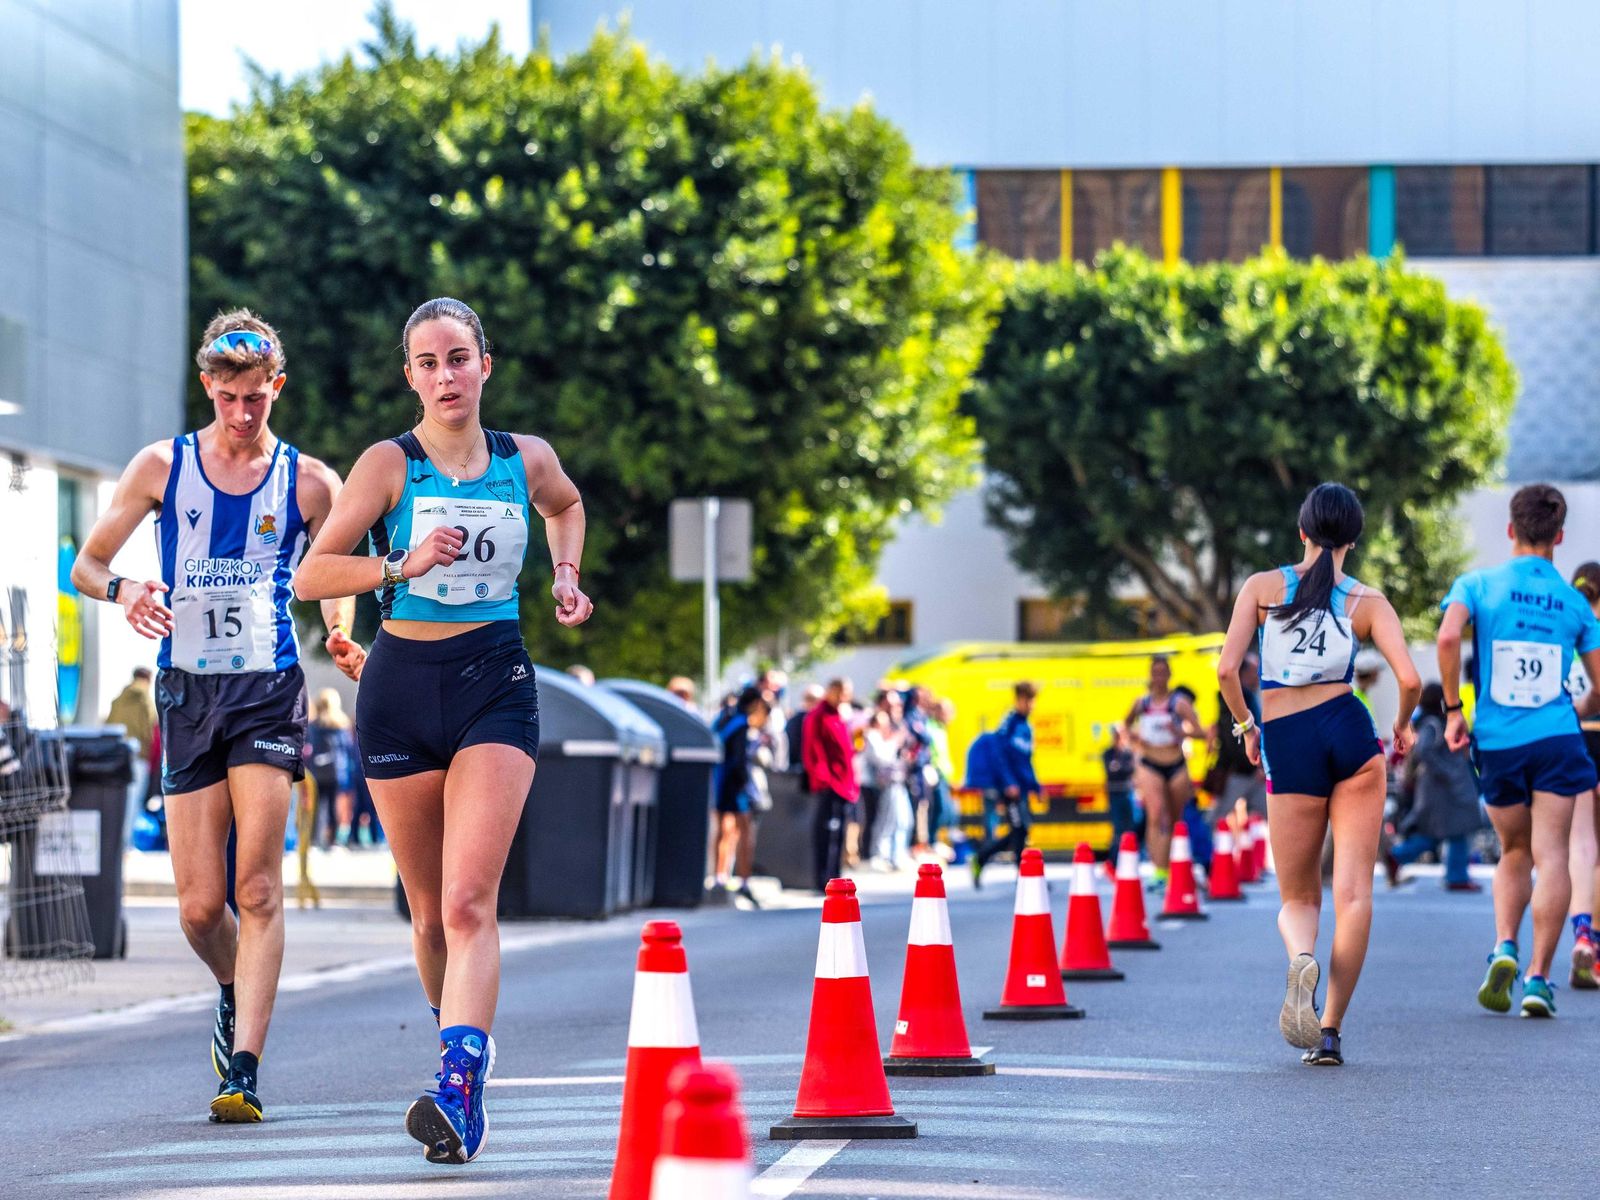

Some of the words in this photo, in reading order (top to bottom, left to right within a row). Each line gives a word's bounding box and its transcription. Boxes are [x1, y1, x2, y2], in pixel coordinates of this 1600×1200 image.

[454, 525, 497, 563] 26
[184, 558, 263, 575] GIPUZKOA
[1510, 590, 1564, 611] nerja
[203, 606, 242, 640] 15
[1291, 627, 1326, 657] 24
[1514, 658, 1543, 680] 39
[254, 740, 295, 756] macron
